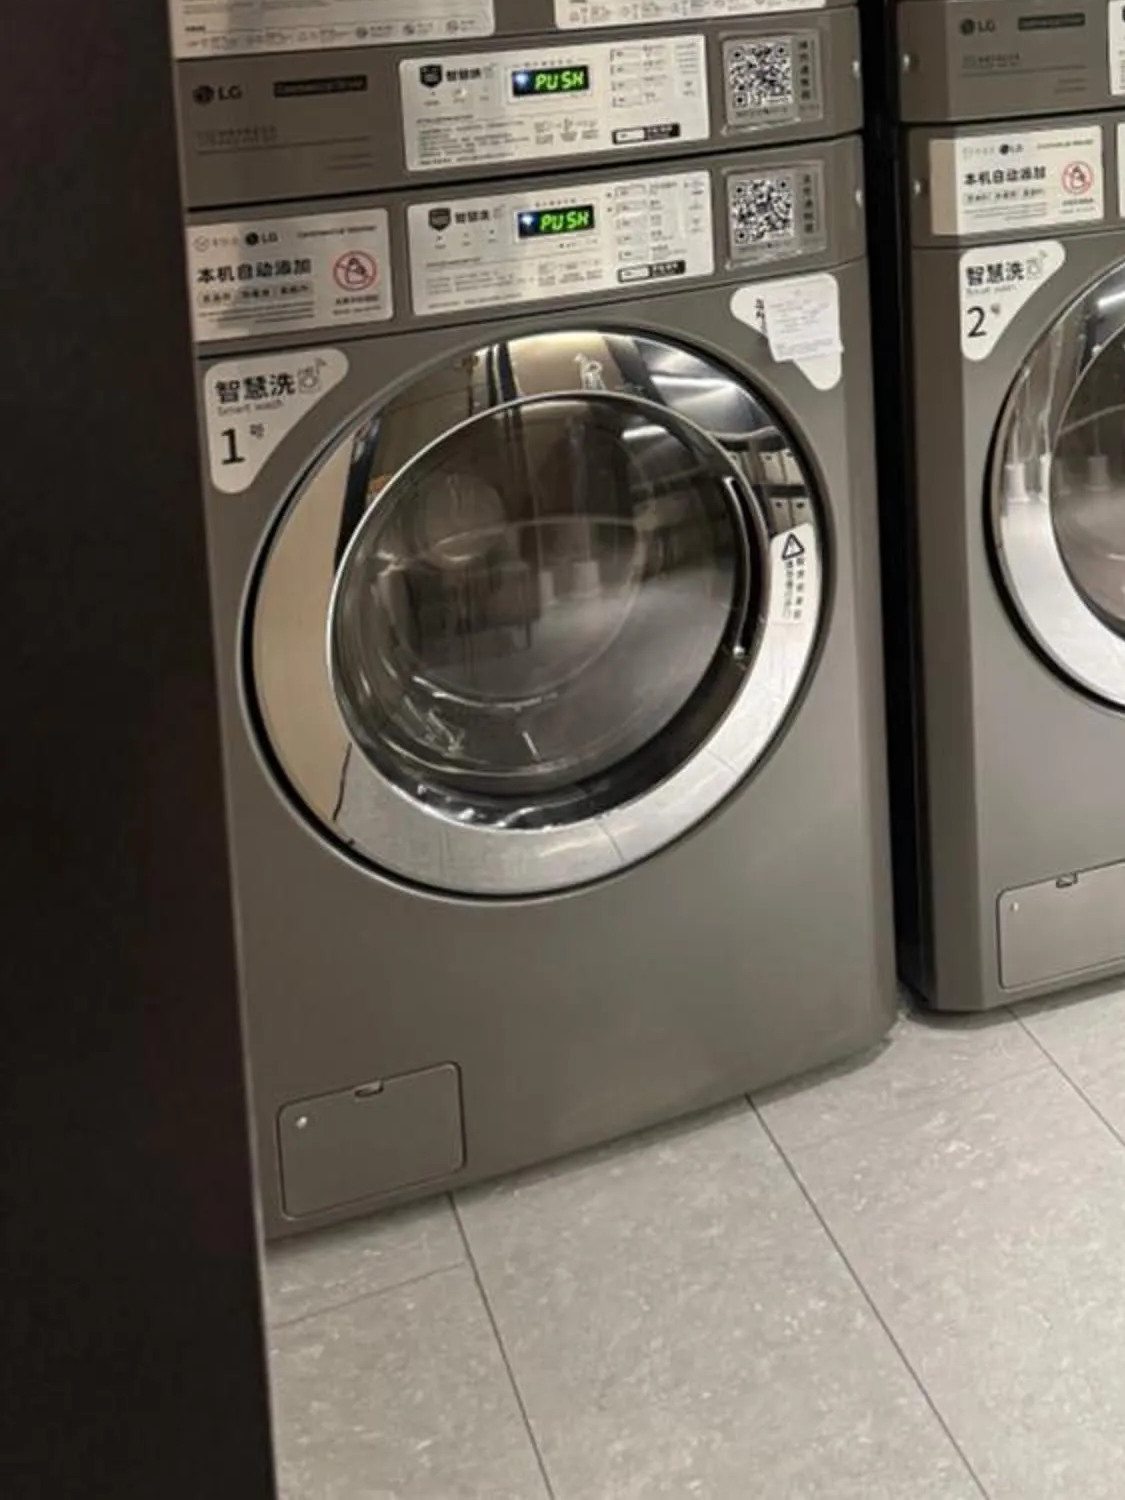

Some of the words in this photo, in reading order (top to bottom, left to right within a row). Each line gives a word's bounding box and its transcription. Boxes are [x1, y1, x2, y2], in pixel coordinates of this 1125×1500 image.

[534, 71, 584, 90] PUSH
[218, 86, 243, 101] LG
[963, 165, 1047, 186] 本机自动添加
[538, 209, 590, 231] PUSH
[197, 258, 312, 284] 本机自动添加
[966, 261, 1025, 286] 智慧洗
[215, 372, 297, 404] 智慧洗
